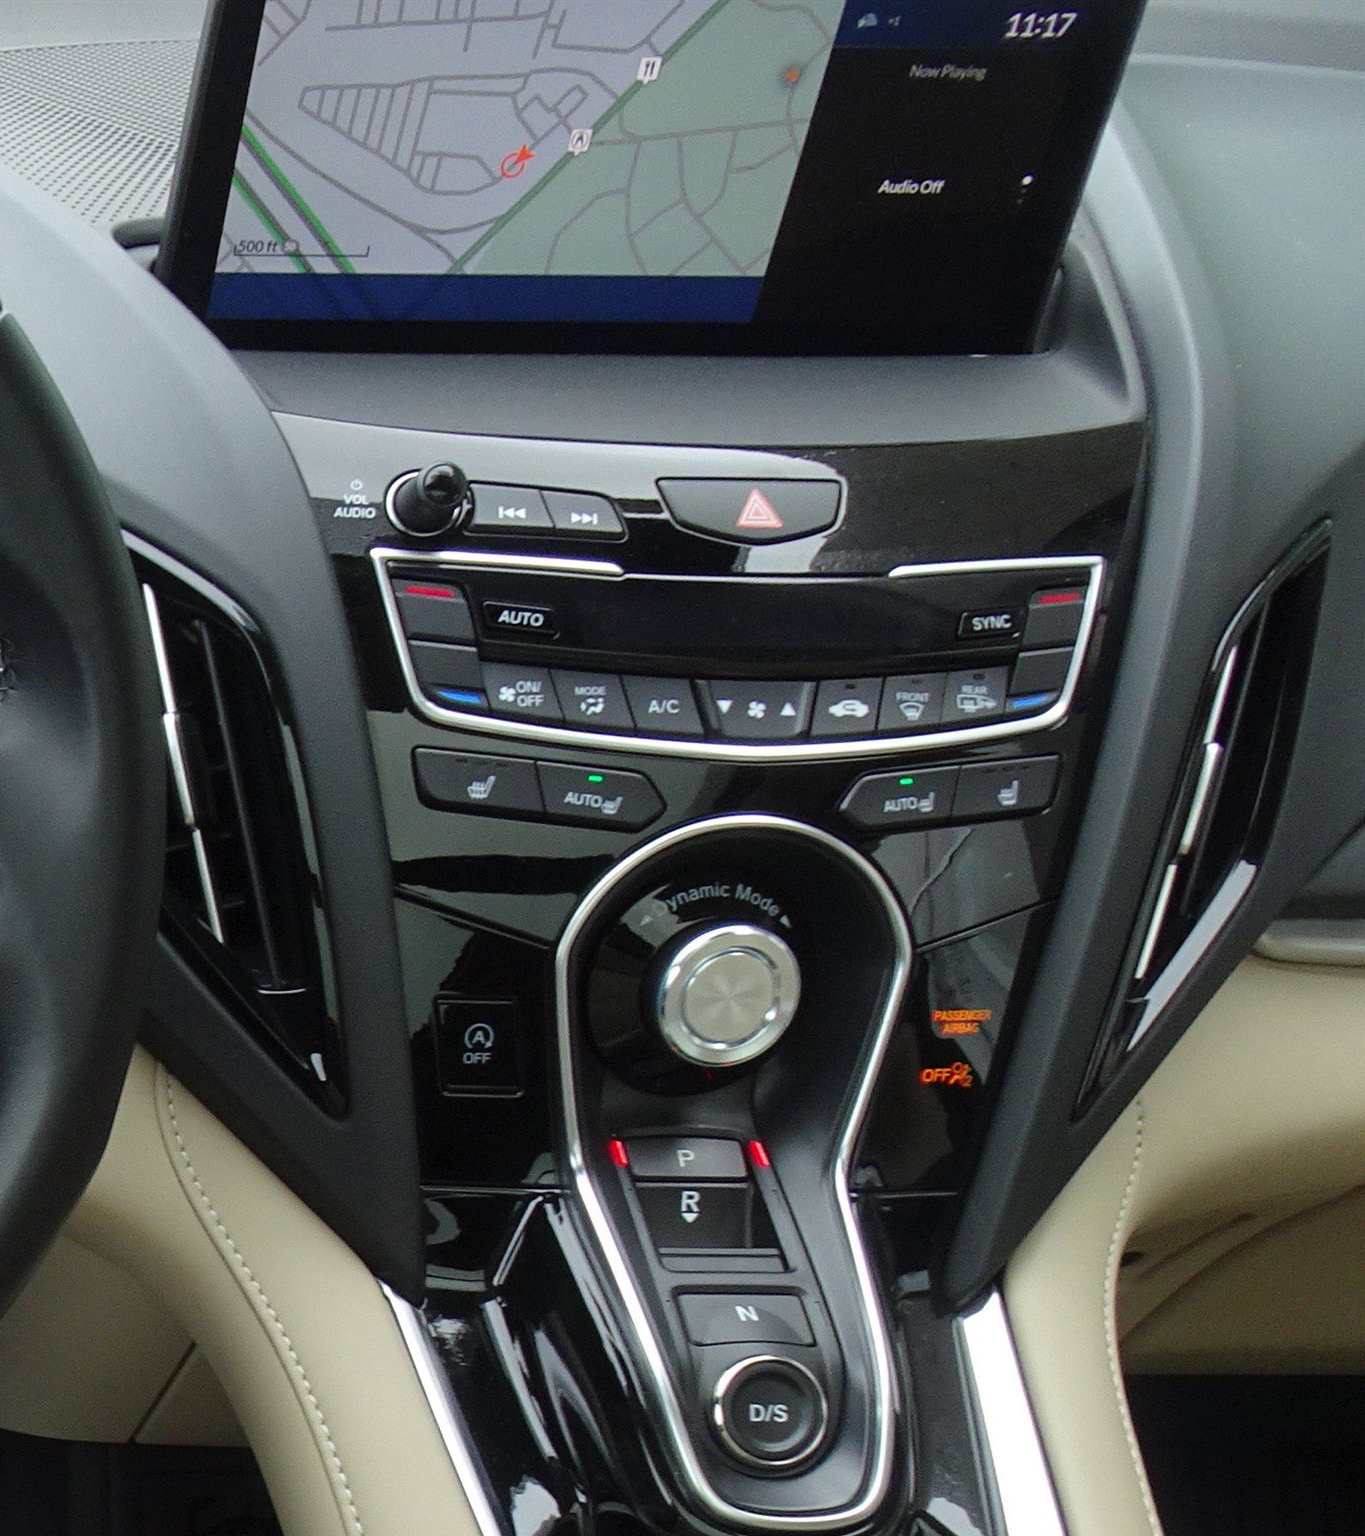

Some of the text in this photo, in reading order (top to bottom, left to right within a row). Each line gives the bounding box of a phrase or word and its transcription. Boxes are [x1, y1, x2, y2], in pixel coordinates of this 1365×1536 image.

[1004, 12, 1077, 39] 11:17
[910, 64, 987, 82] Now Playing
[878, 179, 945, 194] Audio Off
[238, 240, 278, 253] 500 ft
[343, 494, 369, 505] VOL
[333, 507, 376, 519] AUDIO
[498, 610, 544, 627] AUTO
[971, 614, 1012, 631] SYNC
[516, 681, 542, 693] ON/
[574, 686, 607, 696] MODE
[961, 685, 988, 695] REAR
[517, 694, 545, 708] OFF
[895, 691, 929, 703] FRONT
[648, 699, 680, 714] A/C
[563, 791, 603, 808] AUTO
[883, 796, 918, 813] AUTO
[651, 883, 780, 916] Dynamic Mode
[932, 1009, 992, 1022] PASSENGER
[941, 1023, 980, 1034] AIRBAG
[462, 1052, 492, 1064] OFF
[920, 1068, 952, 1084] OFF
[677, 1149, 694, 1168] P
[680, 1191, 699, 1211] R
[735, 1306, 758, 1321] N
[749, 1404, 789, 1423] D/S
